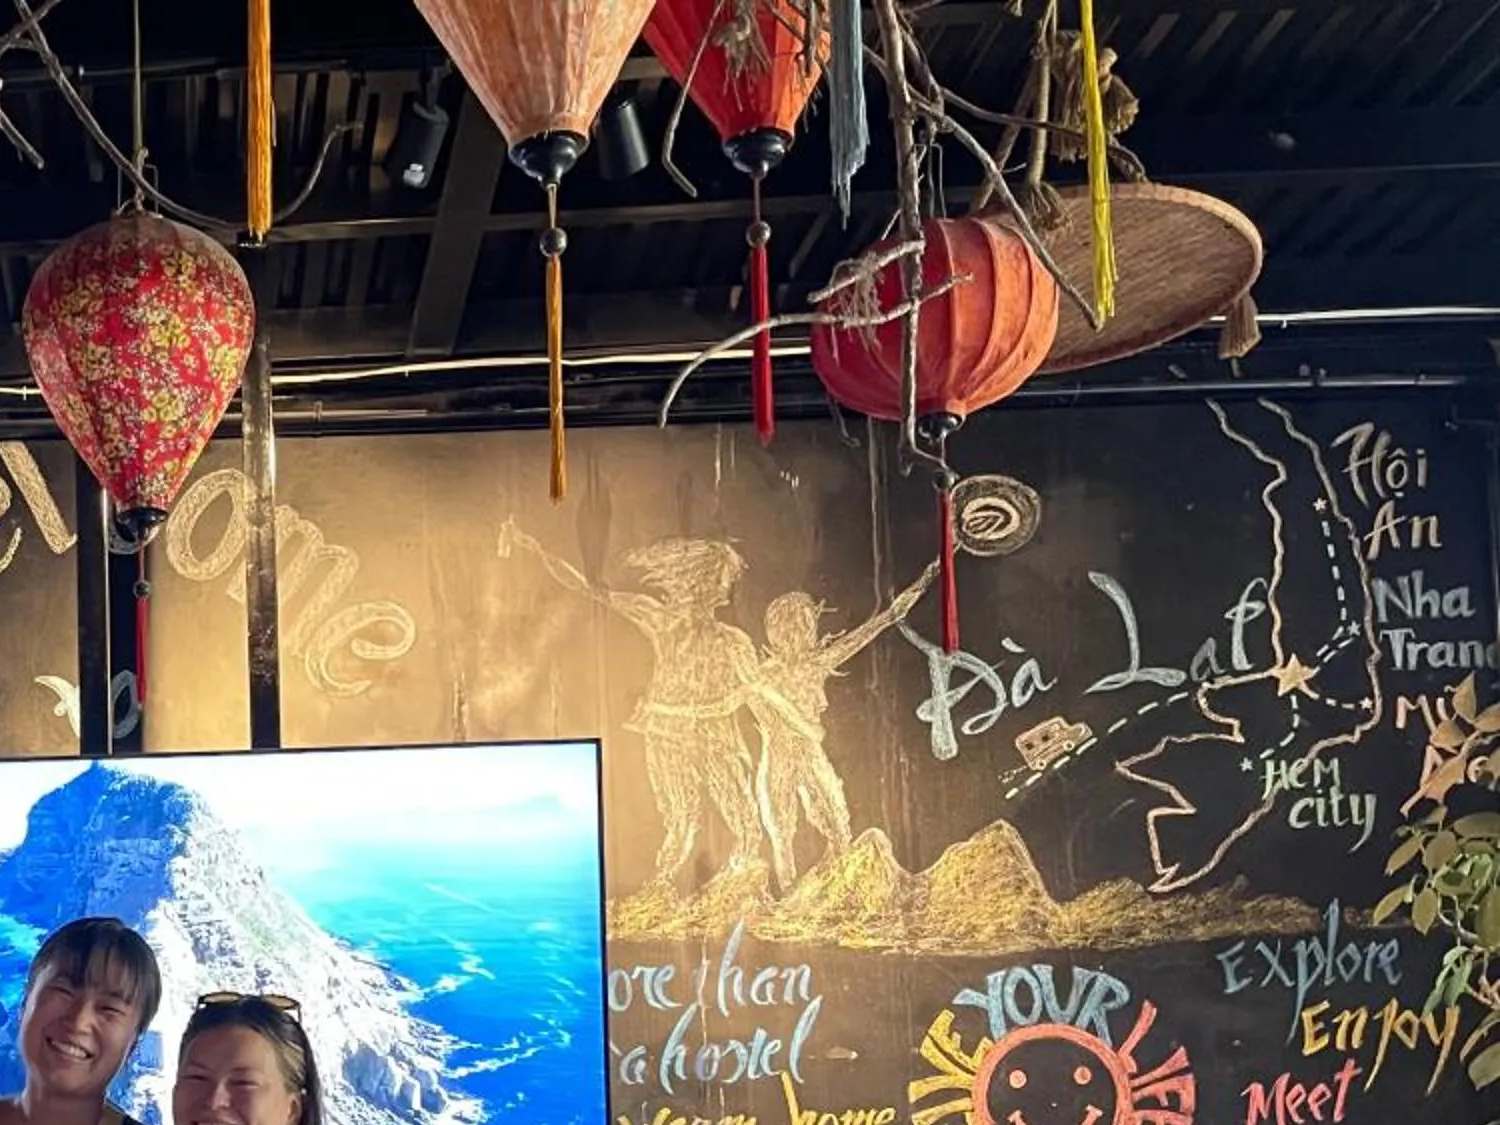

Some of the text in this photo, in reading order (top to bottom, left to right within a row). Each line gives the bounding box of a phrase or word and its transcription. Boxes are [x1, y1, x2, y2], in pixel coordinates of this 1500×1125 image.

[1332, 422, 1427, 507] Hội
[1362, 501, 1443, 560] An
[1372, 570, 1476, 622] Nha
[1289, 785, 1377, 853] city
[606, 963, 684, 1012] ore
[953, 963, 1131, 1046] YOUR
[1216, 897, 1402, 1044] Explore
[660, 995, 824, 1096] hostel
[1302, 997, 1461, 1096] Enjoy
